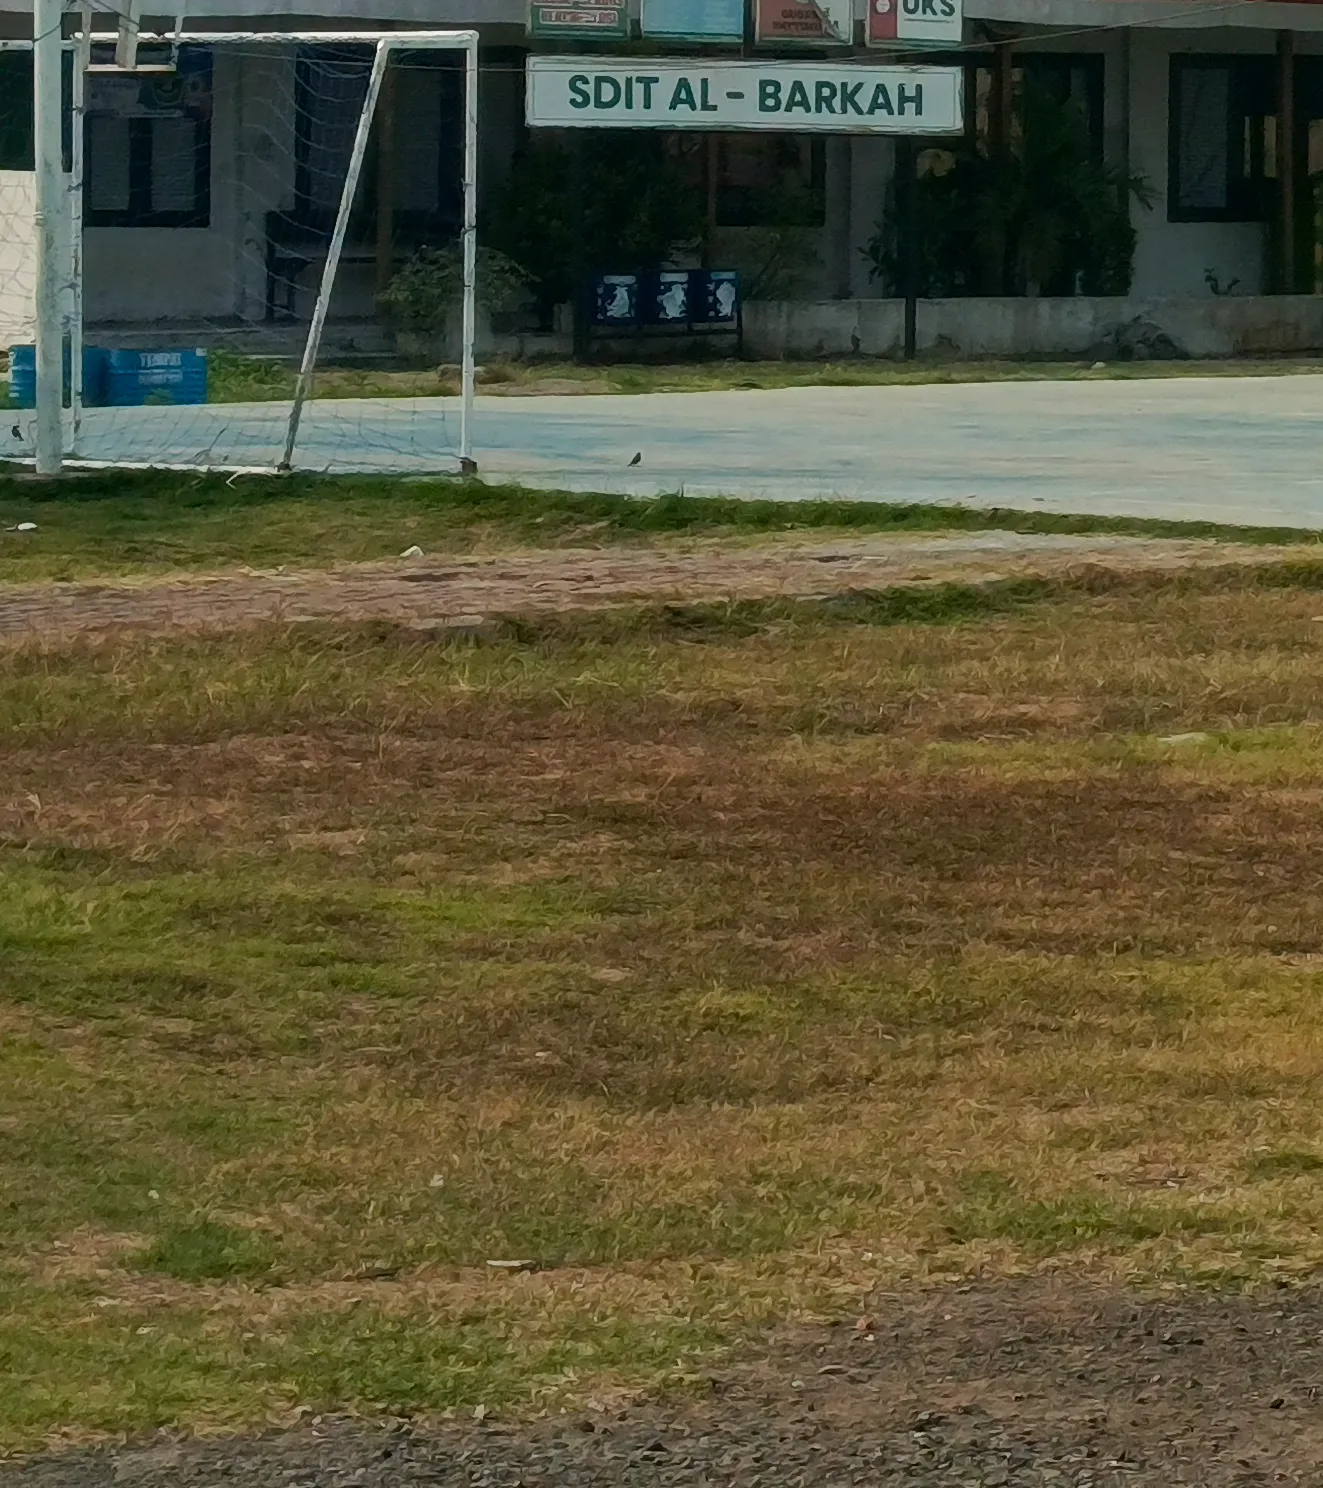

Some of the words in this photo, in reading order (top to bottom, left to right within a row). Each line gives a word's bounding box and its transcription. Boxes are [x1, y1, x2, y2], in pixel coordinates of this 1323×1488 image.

[568, 74, 660, 110] SDIT
[669, 77, 718, 112] AL
[758, 79, 923, 117] BARKAH
